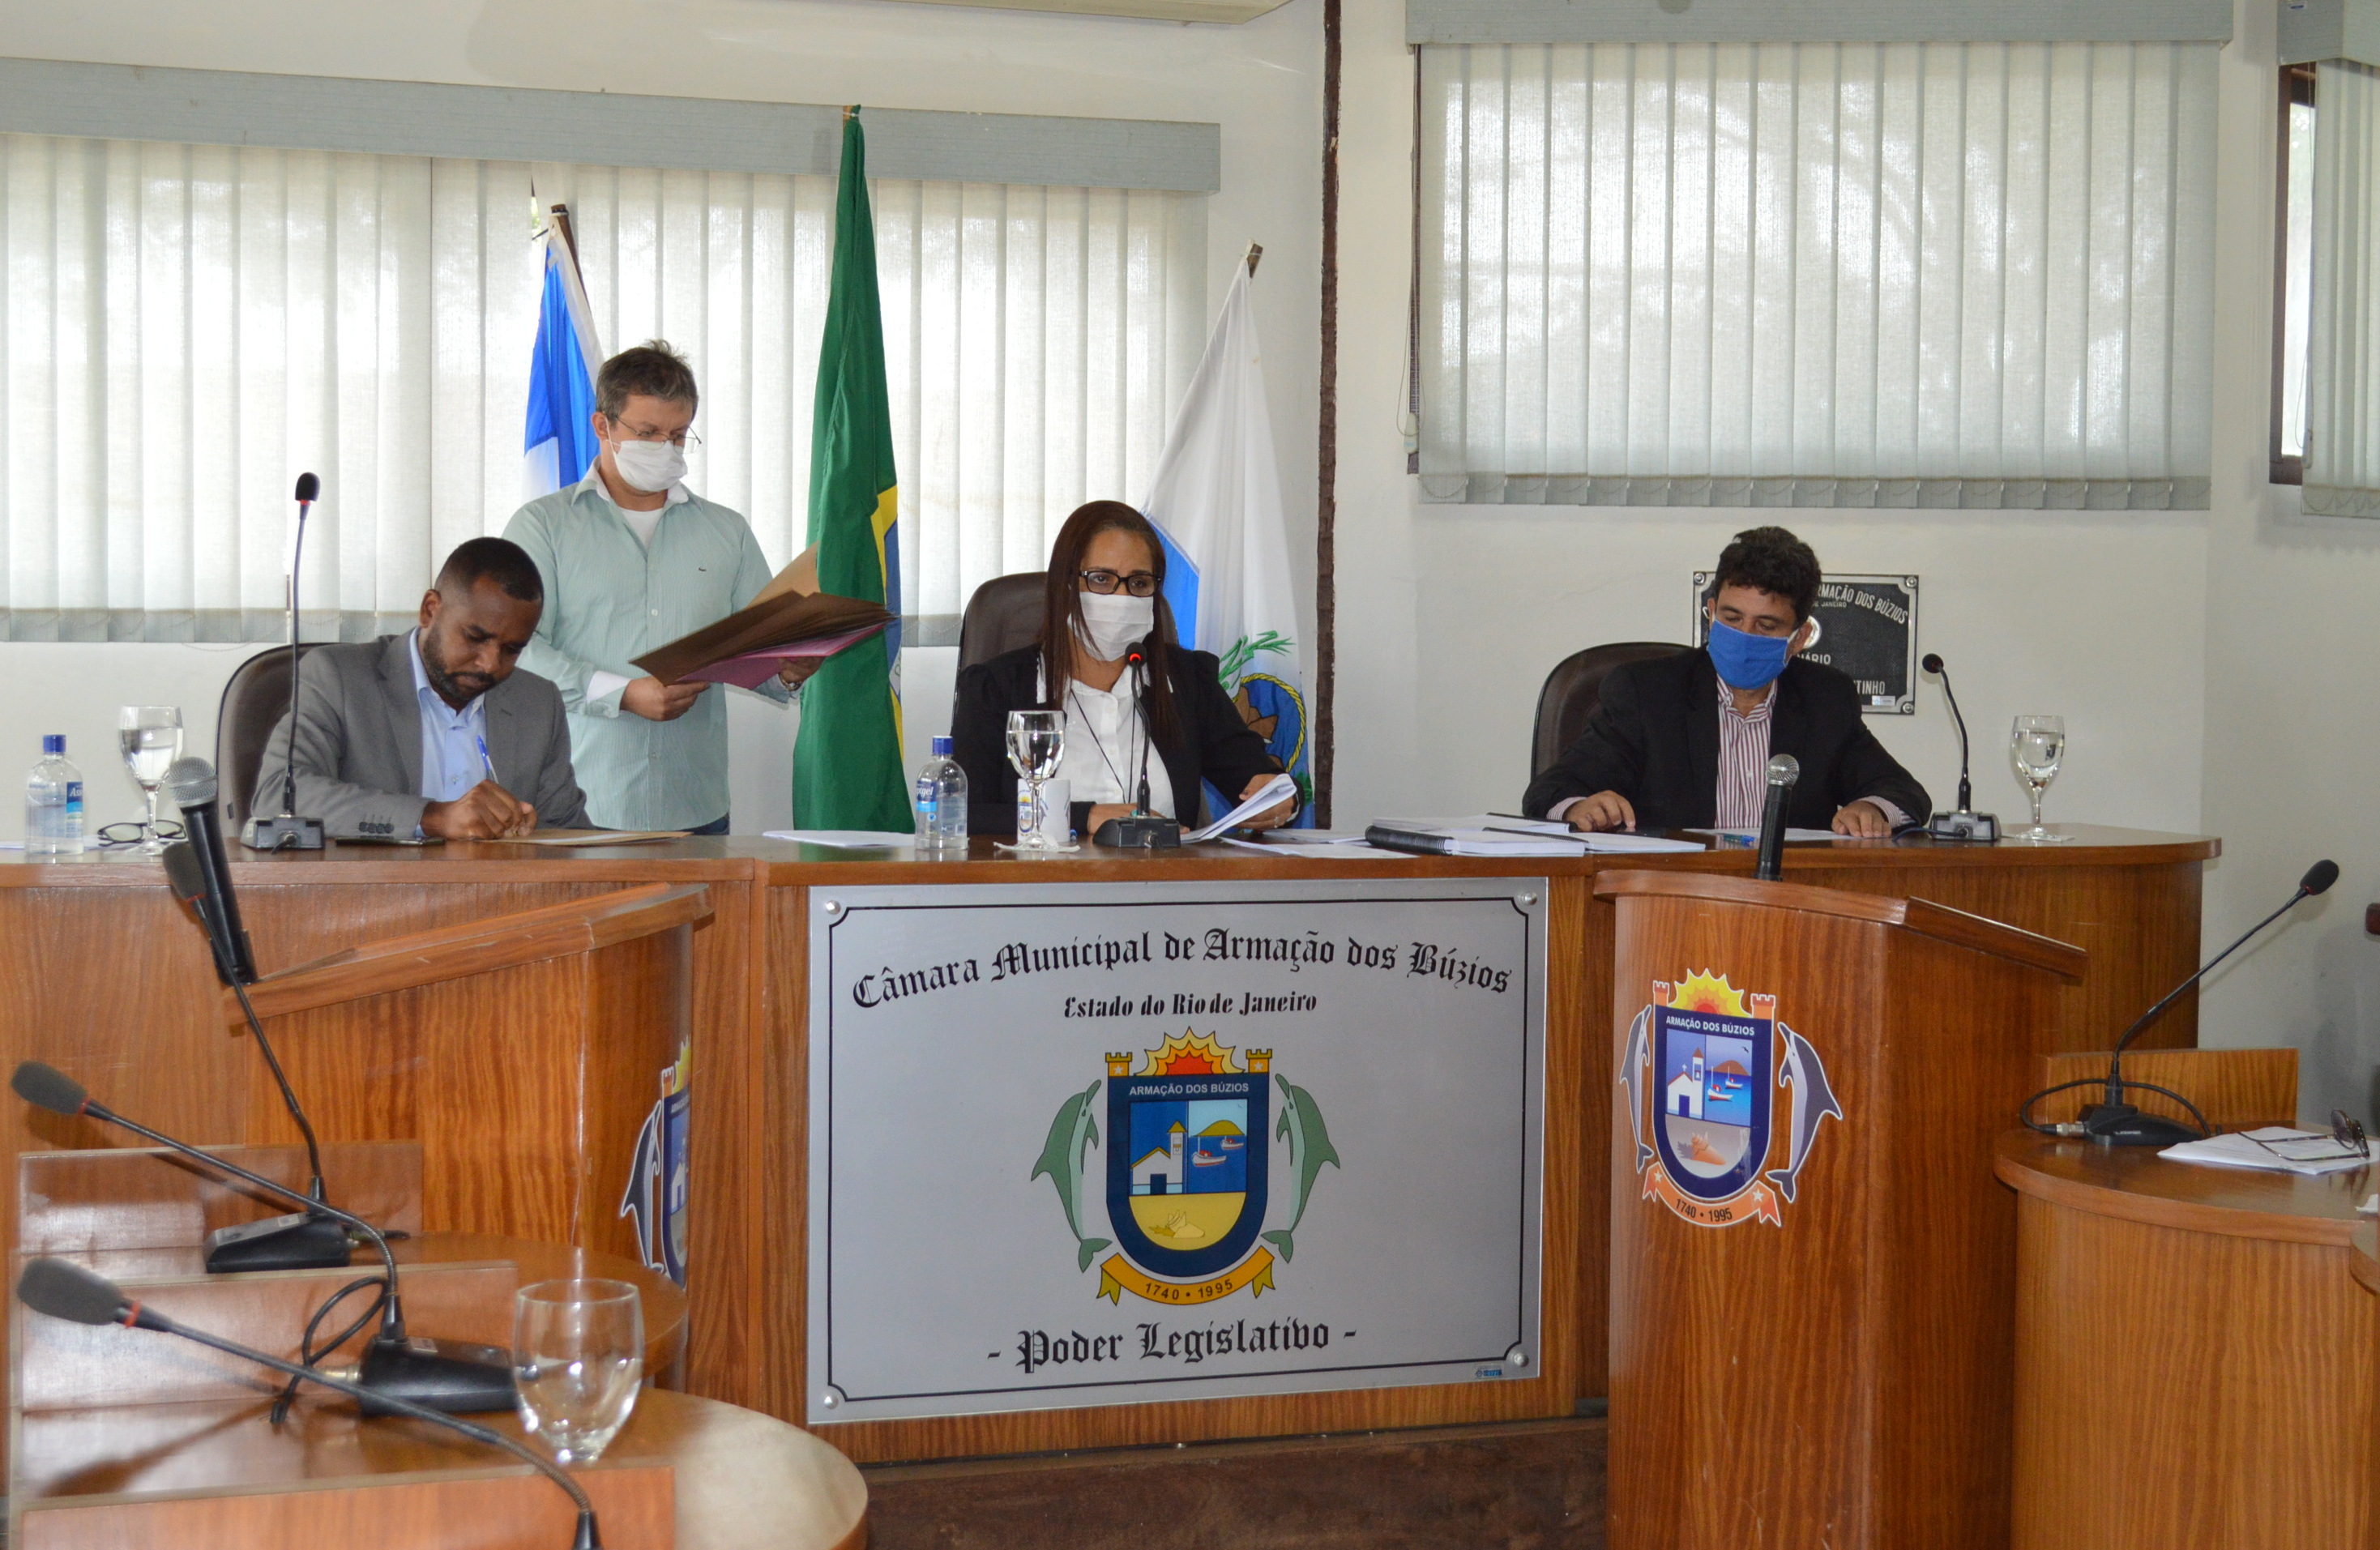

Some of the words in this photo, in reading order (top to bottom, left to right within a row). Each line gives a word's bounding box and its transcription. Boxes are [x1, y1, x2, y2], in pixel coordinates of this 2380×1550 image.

[1855, 591, 1875, 609] DOS
[1874, 598, 1908, 625] BÚZIOS
[852, 966, 981, 1009] Câmara
[991, 931, 1152, 982] Municipal
[1164, 931, 1195, 961] de
[1203, 928, 1335, 972] Armação
[1347, 937, 1399, 971] dos
[1406, 942, 1512, 994] Búzios
[1064, 995, 1134, 1018] Estado
[1140, 994, 1165, 1016] do
[1172, 993, 1206, 1015] Rio
[1209, 993, 1233, 1014] de
[1238, 990, 1318, 1016] Janeiro
[1666, 1015, 1701, 1030] ARMAÇÃO
[1703, 1021, 1720, 1032] DOS
[1722, 1022, 1755, 1036] BÚZIOS
[1130, 1082, 1183, 1096] ARMAÇÃO
[1186, 1084, 1207, 1094] DOS
[1211, 1081, 1249, 1093] BÚZIOS
[1676, 1199, 1697, 1219] 1740
[1708, 1207, 1733, 1222] 1995
[1146, 1283, 1180, 1300] 1740
[1198, 1279, 1233, 1298] 1995
[1015, 1330, 1124, 1374] Poder
[1136, 1316, 1330, 1364] Legislativo
